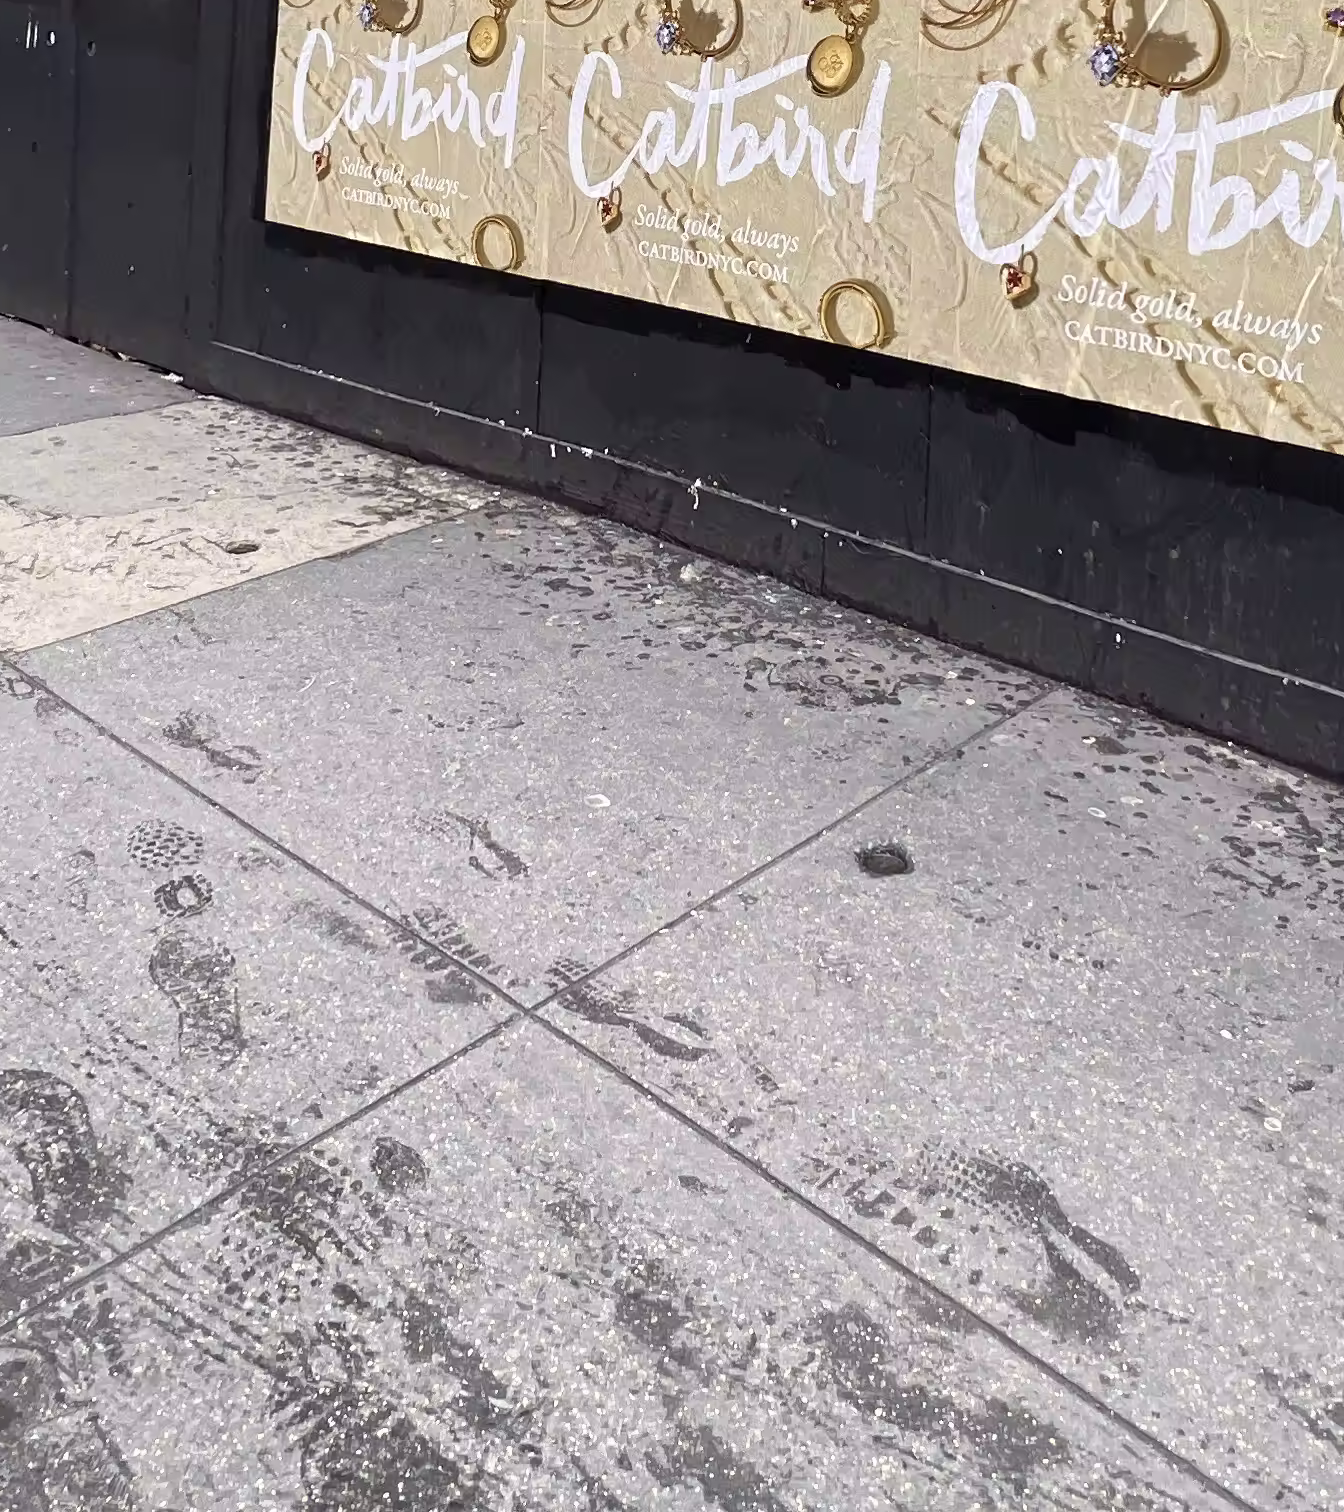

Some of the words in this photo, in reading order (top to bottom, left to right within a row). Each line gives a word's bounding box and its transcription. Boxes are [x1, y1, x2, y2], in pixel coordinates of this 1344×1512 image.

[293, 28, 525, 169] Catbird
[568, 51, 891, 223] Catbird
[340, 156, 375, 179] Solid
[373, 163, 406, 187] gold,
[411, 168, 459, 199] always
[342, 186, 450, 219] CATBIRDNYC.COM
[635, 203, 681, 233] Solid
[681, 213, 725, 243] gold,
[731, 217, 799, 258] always
[638, 240, 788, 283] CATBIRDNYC.COM
[1057, 274, 1127, 311] Solid
[1130, 289, 1202, 328] gold,
[1212, 299, 1322, 352] always
[1064, 320, 1304, 383] CATBIRDNYC.COM
